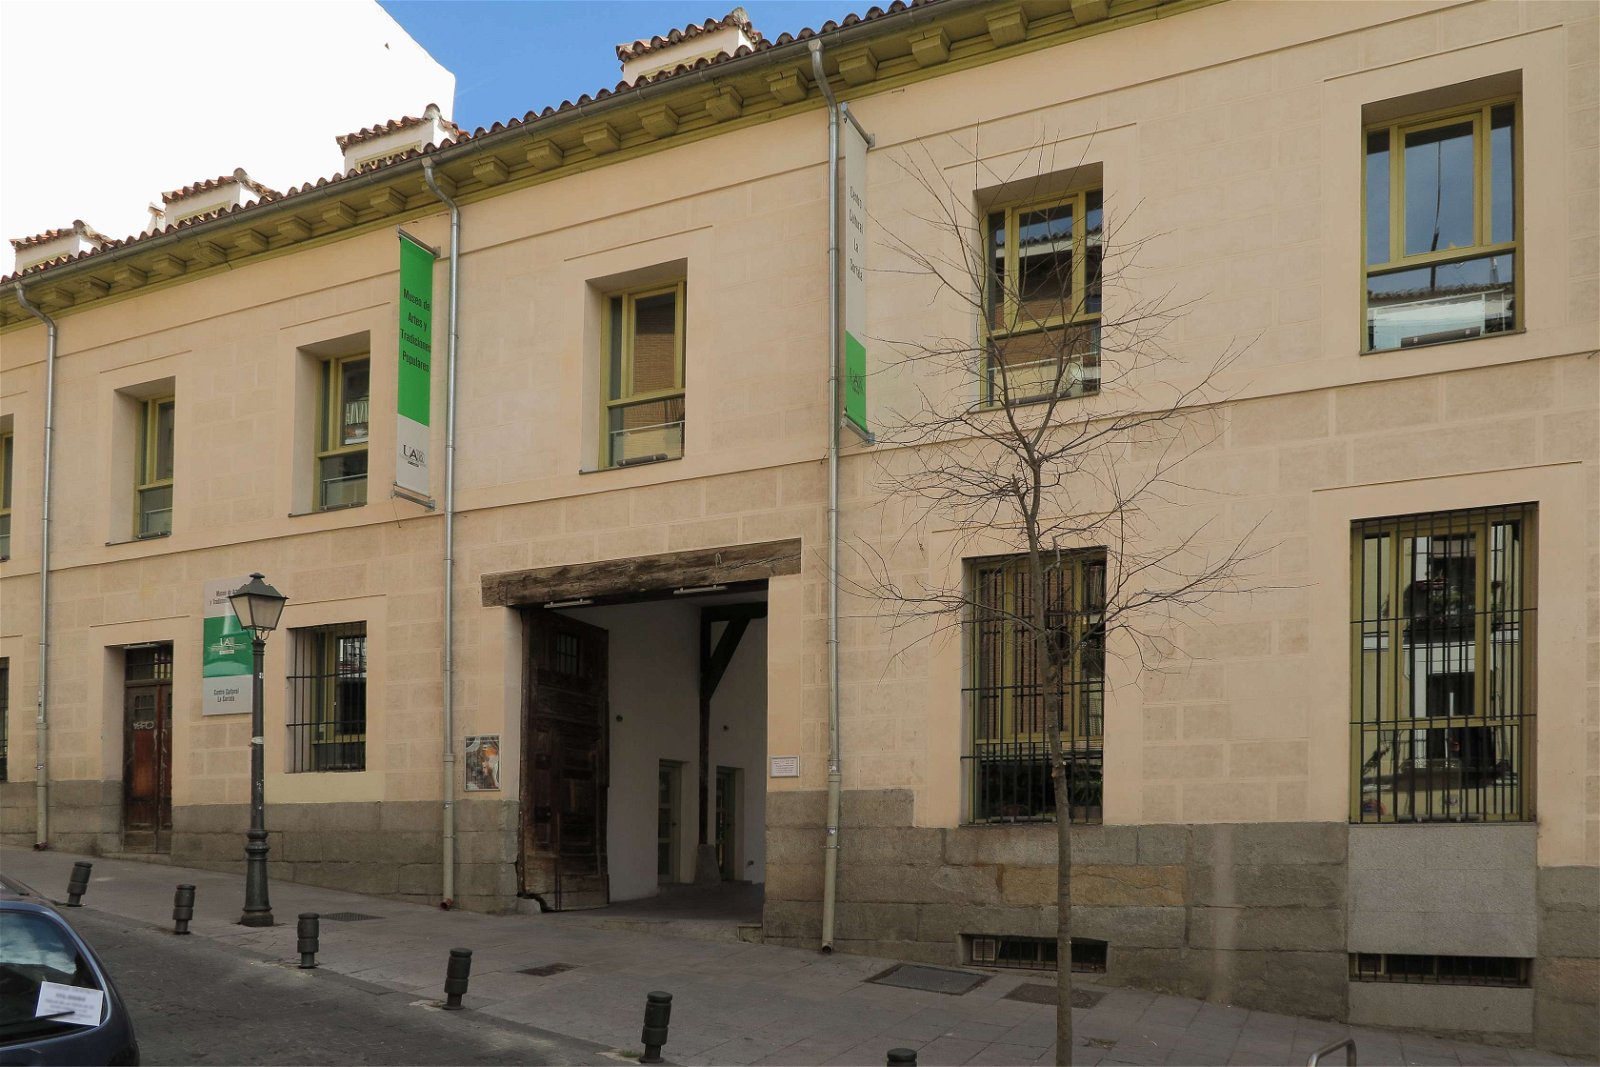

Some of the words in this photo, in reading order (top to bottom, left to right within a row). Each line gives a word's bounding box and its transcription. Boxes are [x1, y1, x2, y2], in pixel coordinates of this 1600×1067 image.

[403, 287, 422, 307] Museo
[423, 300, 431, 312] de
[408, 311, 423, 329] Artes
[423, 320, 428, 333] y
[400, 328, 432, 353] Tradiciones
[402, 350, 430, 373] Populares
